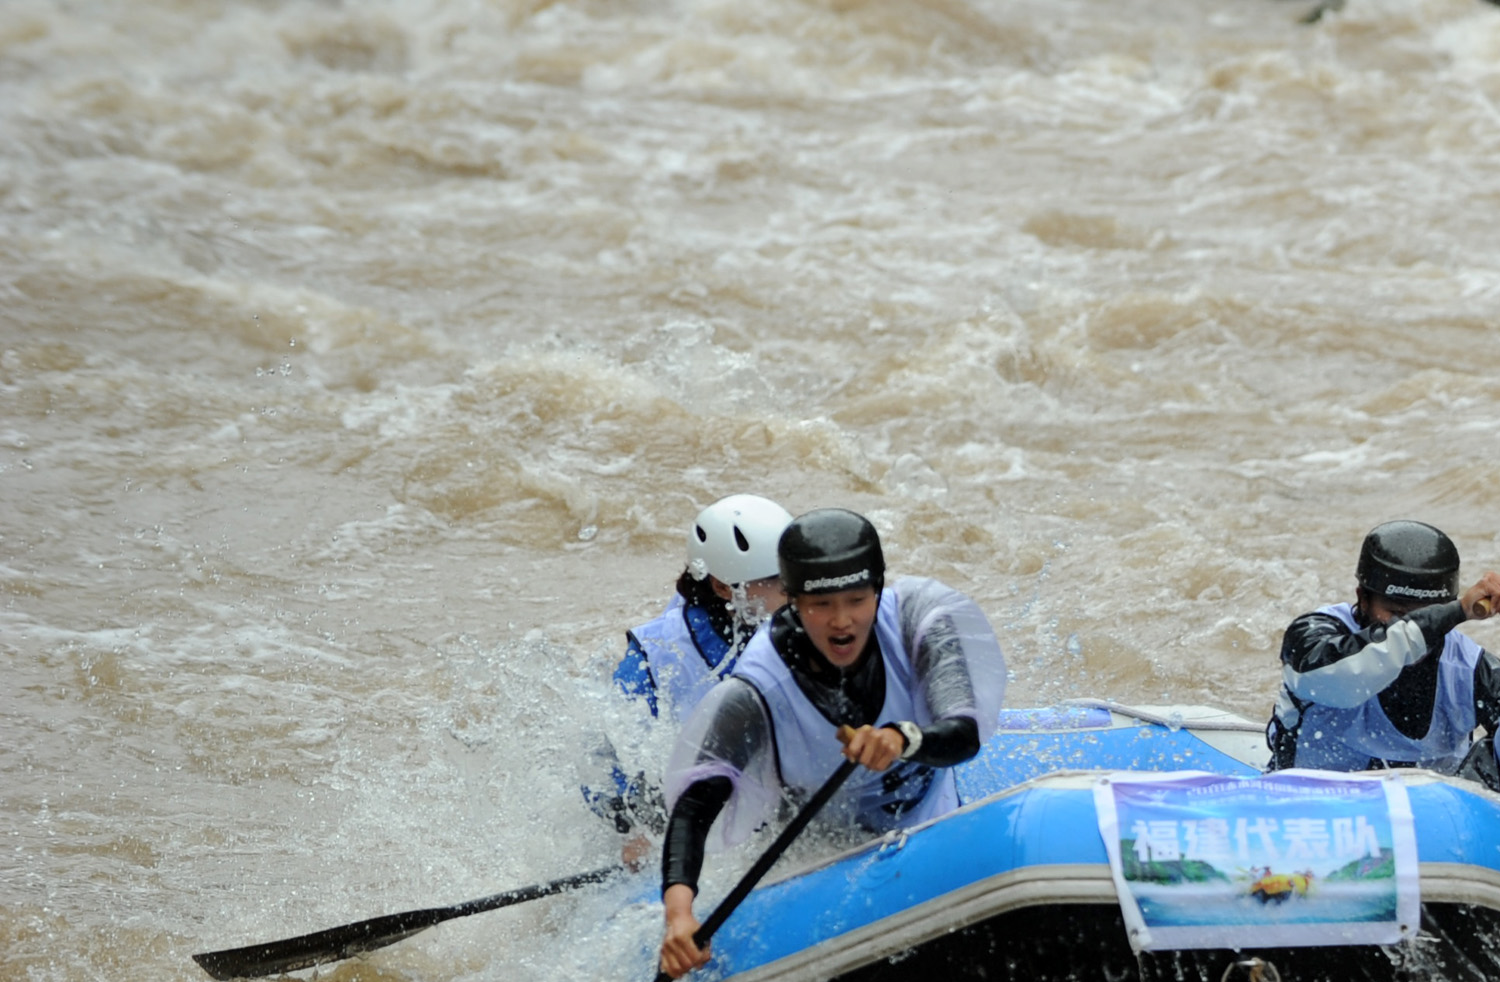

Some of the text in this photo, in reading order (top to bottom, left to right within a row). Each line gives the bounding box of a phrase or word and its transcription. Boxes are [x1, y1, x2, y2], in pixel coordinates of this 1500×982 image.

[804, 569, 869, 592] galasport
[1385, 584, 1449, 599] galasport
[1130, 815, 1384, 863] 福建代表队
